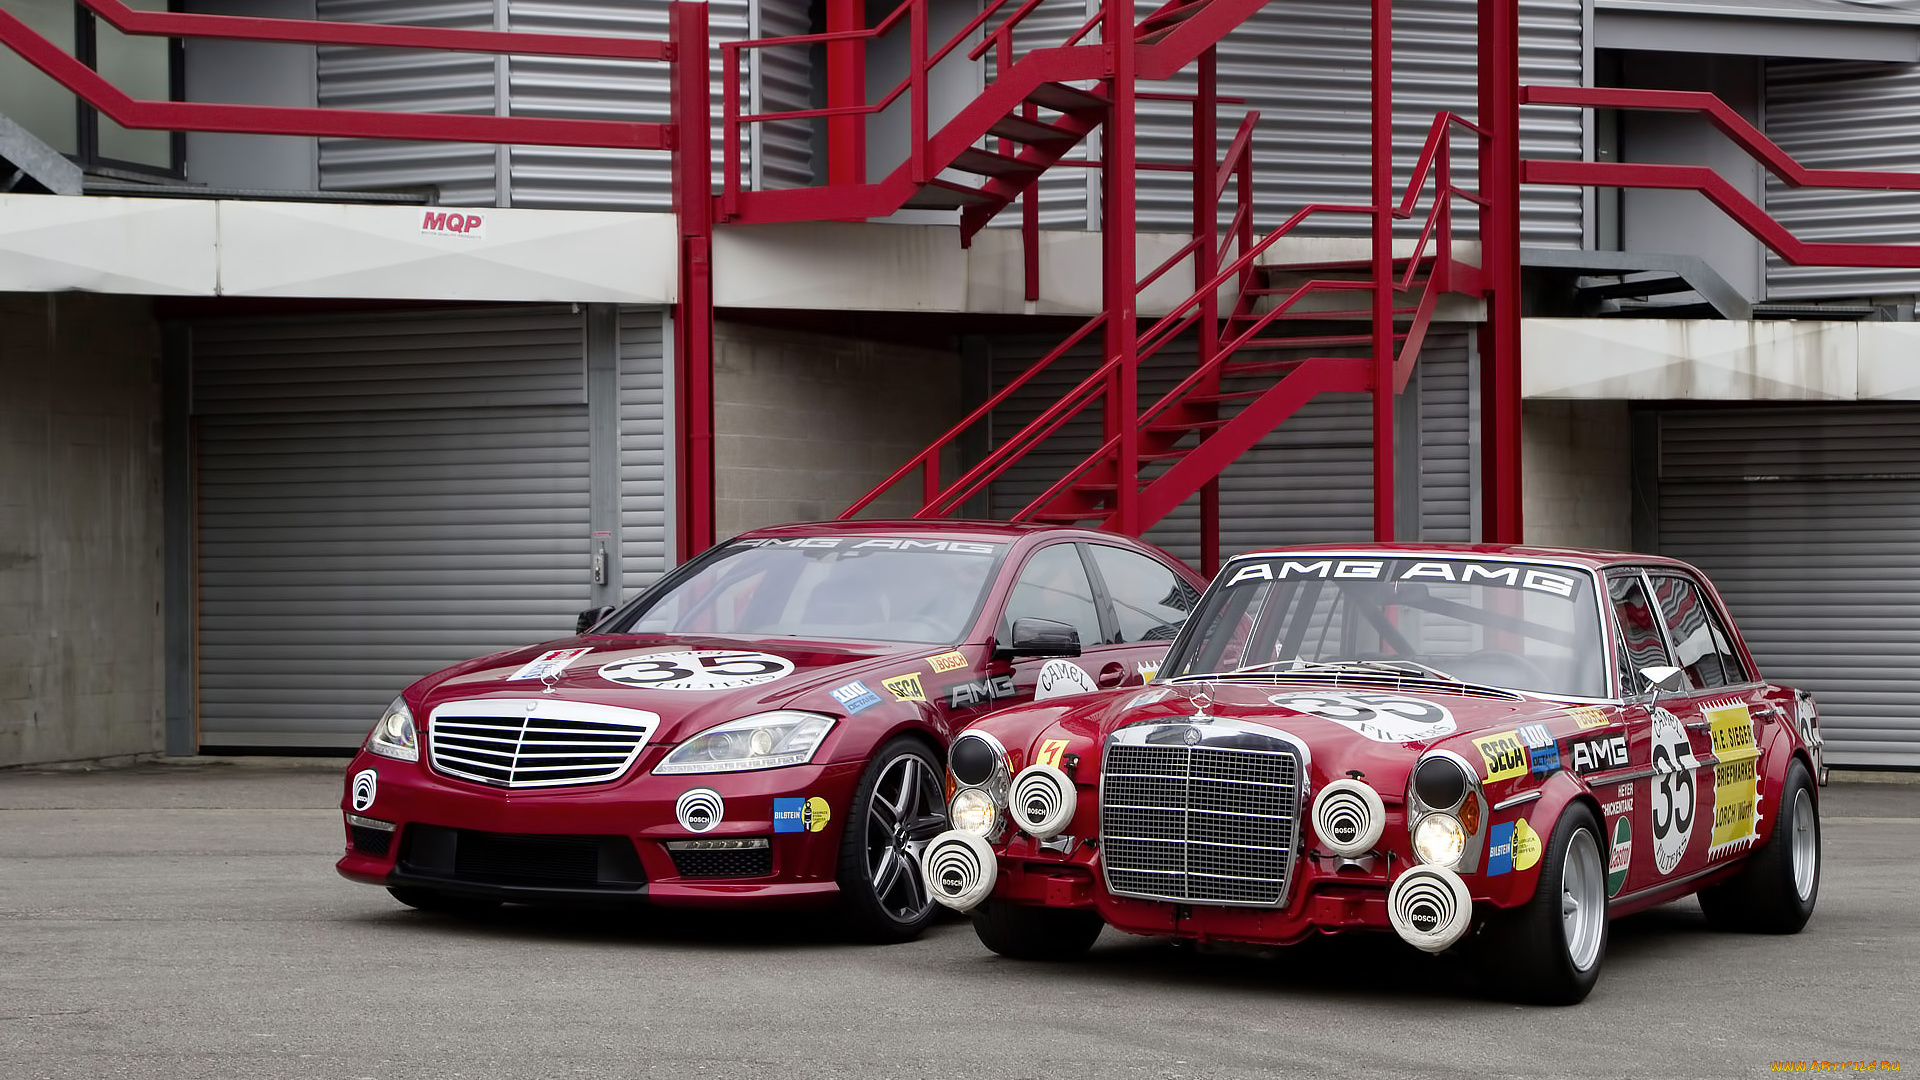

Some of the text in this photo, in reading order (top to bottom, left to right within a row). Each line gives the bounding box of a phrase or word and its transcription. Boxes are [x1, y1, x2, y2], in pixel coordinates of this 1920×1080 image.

[423, 212, 482, 233] MQP
[727, 538, 994, 554] AMG AMG
[1225, 560, 1575, 598] AMG AMG
[603, 654, 785, 683] 35
[936, 654, 966, 670] BOSCH
[888, 678, 922, 698] SECA
[1041, 662, 1089, 692] CAMEL
[833, 681, 869, 702] 100
[848, 695, 878, 710] OCTANE
[951, 675, 1016, 709] AMG
[1274, 694, 1444, 724] 35
[1728, 724, 1753, 748] SIEGER
[1481, 738, 1524, 773] SECA
[1574, 737, 1629, 772] AMG
[1717, 761, 1755, 788] BRIEFMARKEN
[1652, 741, 1694, 840] 35
[774, 811, 801, 820] BILSTEIN
[1027, 807, 1046, 816] BOSCH
[1602, 798, 1633, 817] CHICKENTANZ
[1490, 843, 1510, 857] BILSTEIN
[1610, 846, 1629, 869] Castrol
[1656, 835, 1687, 871] FILTERS
[942, 879, 963, 887] BOSCH
[1412, 914, 1437, 923] BOSCH
